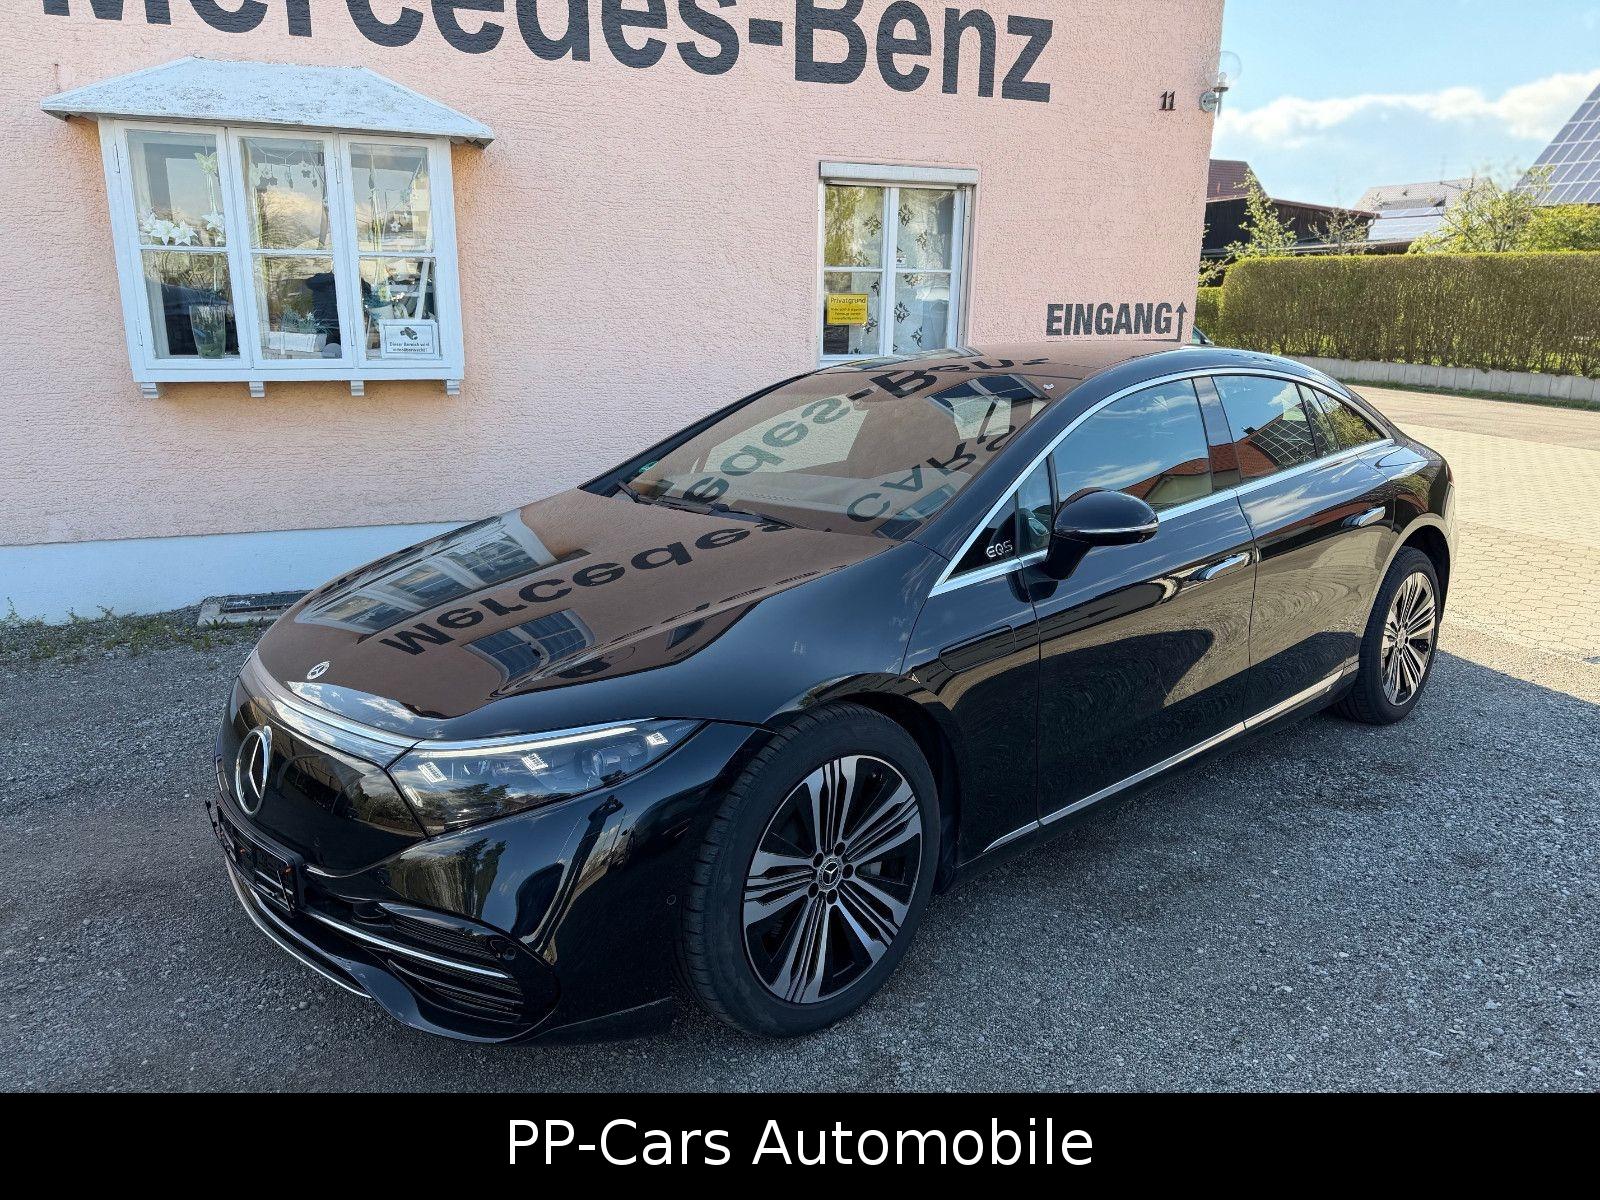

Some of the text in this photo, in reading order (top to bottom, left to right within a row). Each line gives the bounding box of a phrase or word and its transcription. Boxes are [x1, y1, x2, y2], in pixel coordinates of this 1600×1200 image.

[42, 0, 1053, 103] cedes-Benz
[1159, 90, 1176, 111] 11
[1046, 302, 1173, 336] EINGANG
[986, 540, 1013, 558] EQS
